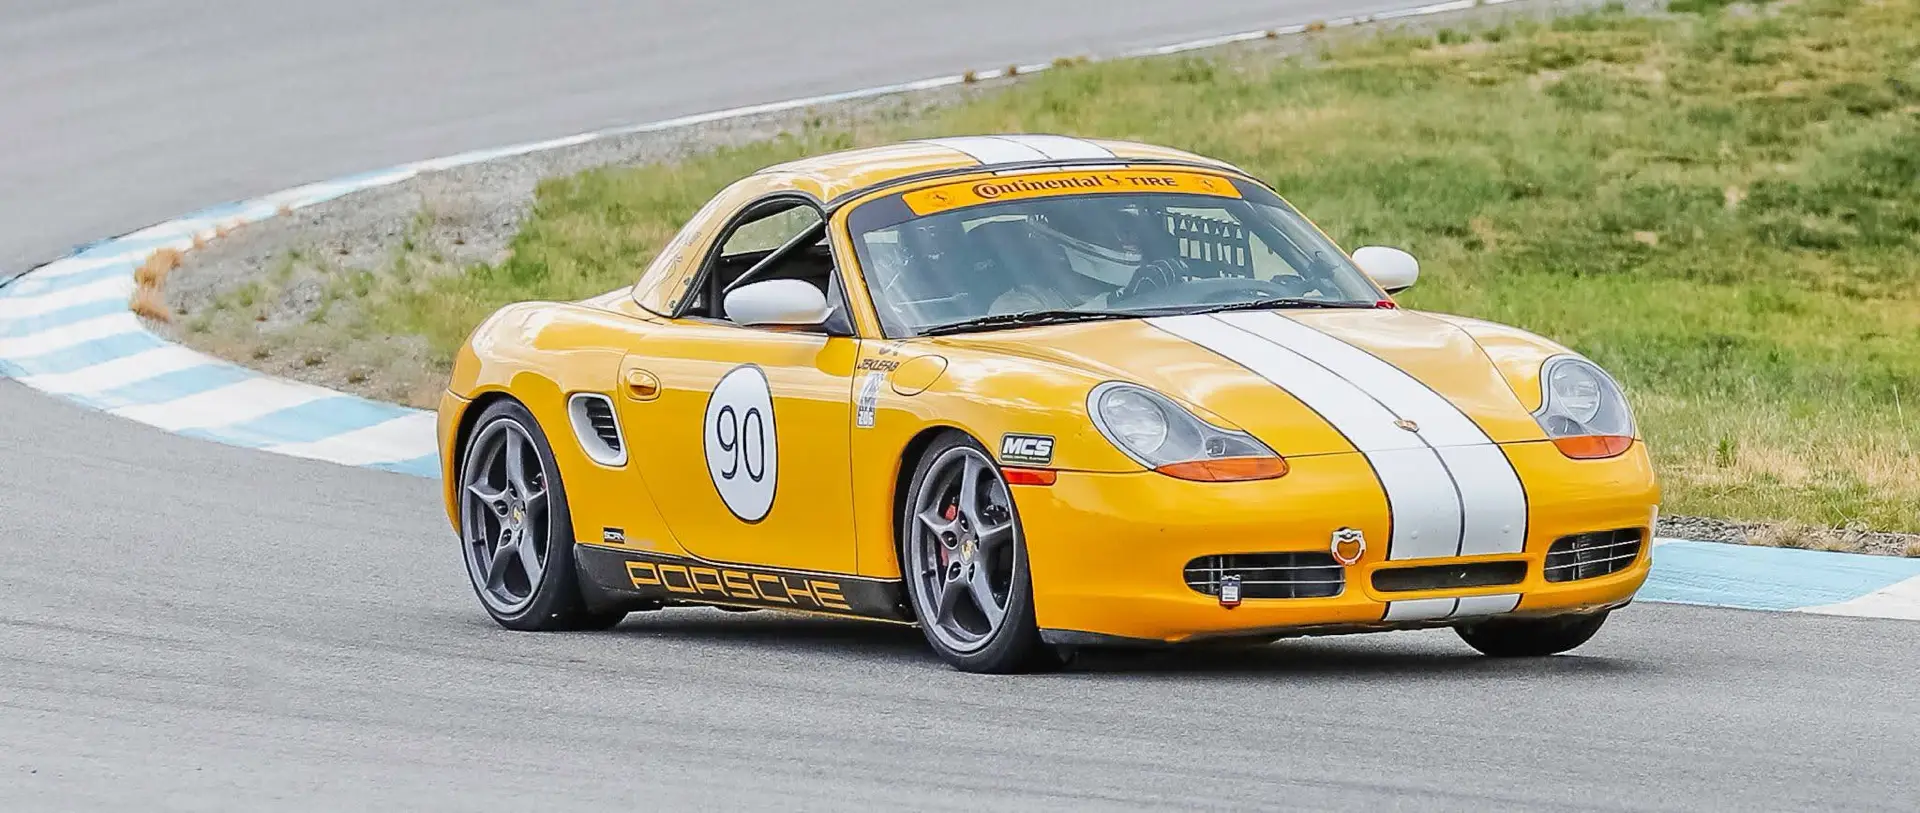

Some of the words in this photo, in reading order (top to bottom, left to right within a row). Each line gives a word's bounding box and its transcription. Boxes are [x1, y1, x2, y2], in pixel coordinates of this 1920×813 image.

[972, 176, 1103, 199] Continental
[1125, 176, 1178, 187] TIRE
[716, 404, 765, 482] 90
[1002, 437, 1053, 457] MCS
[625, 560, 852, 611] PORSCHE
